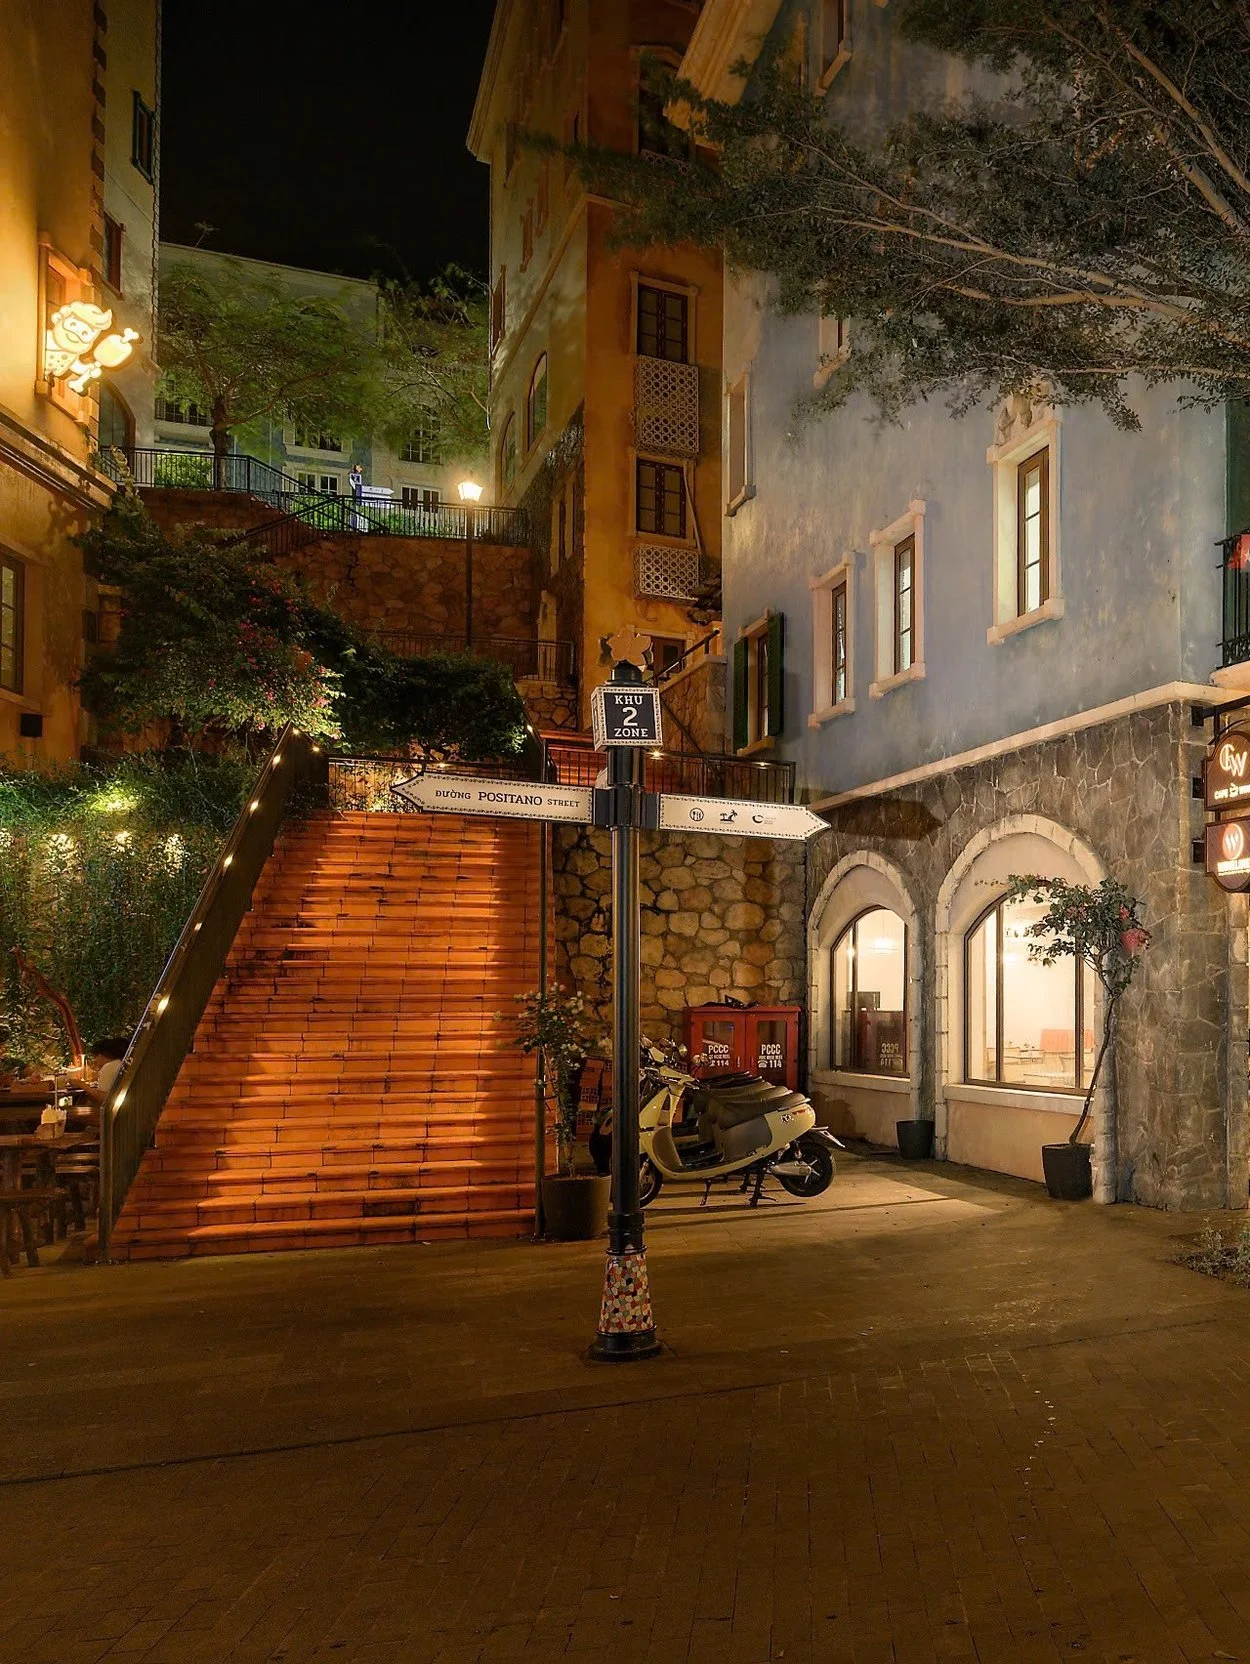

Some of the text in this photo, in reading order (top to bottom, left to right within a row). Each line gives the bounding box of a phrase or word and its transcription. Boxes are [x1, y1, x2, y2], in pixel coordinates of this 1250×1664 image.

[614, 695, 643, 705] KHU
[622, 706, 638, 726] 2
[614, 728, 648, 737] ZONE
[435, 789, 580, 808] ĐƯỜNG POSITANO STREET
[708, 1044, 729, 1054] PCCC
[761, 1043, 781, 1055] PCCC
[769, 1059, 782, 1068] 114
